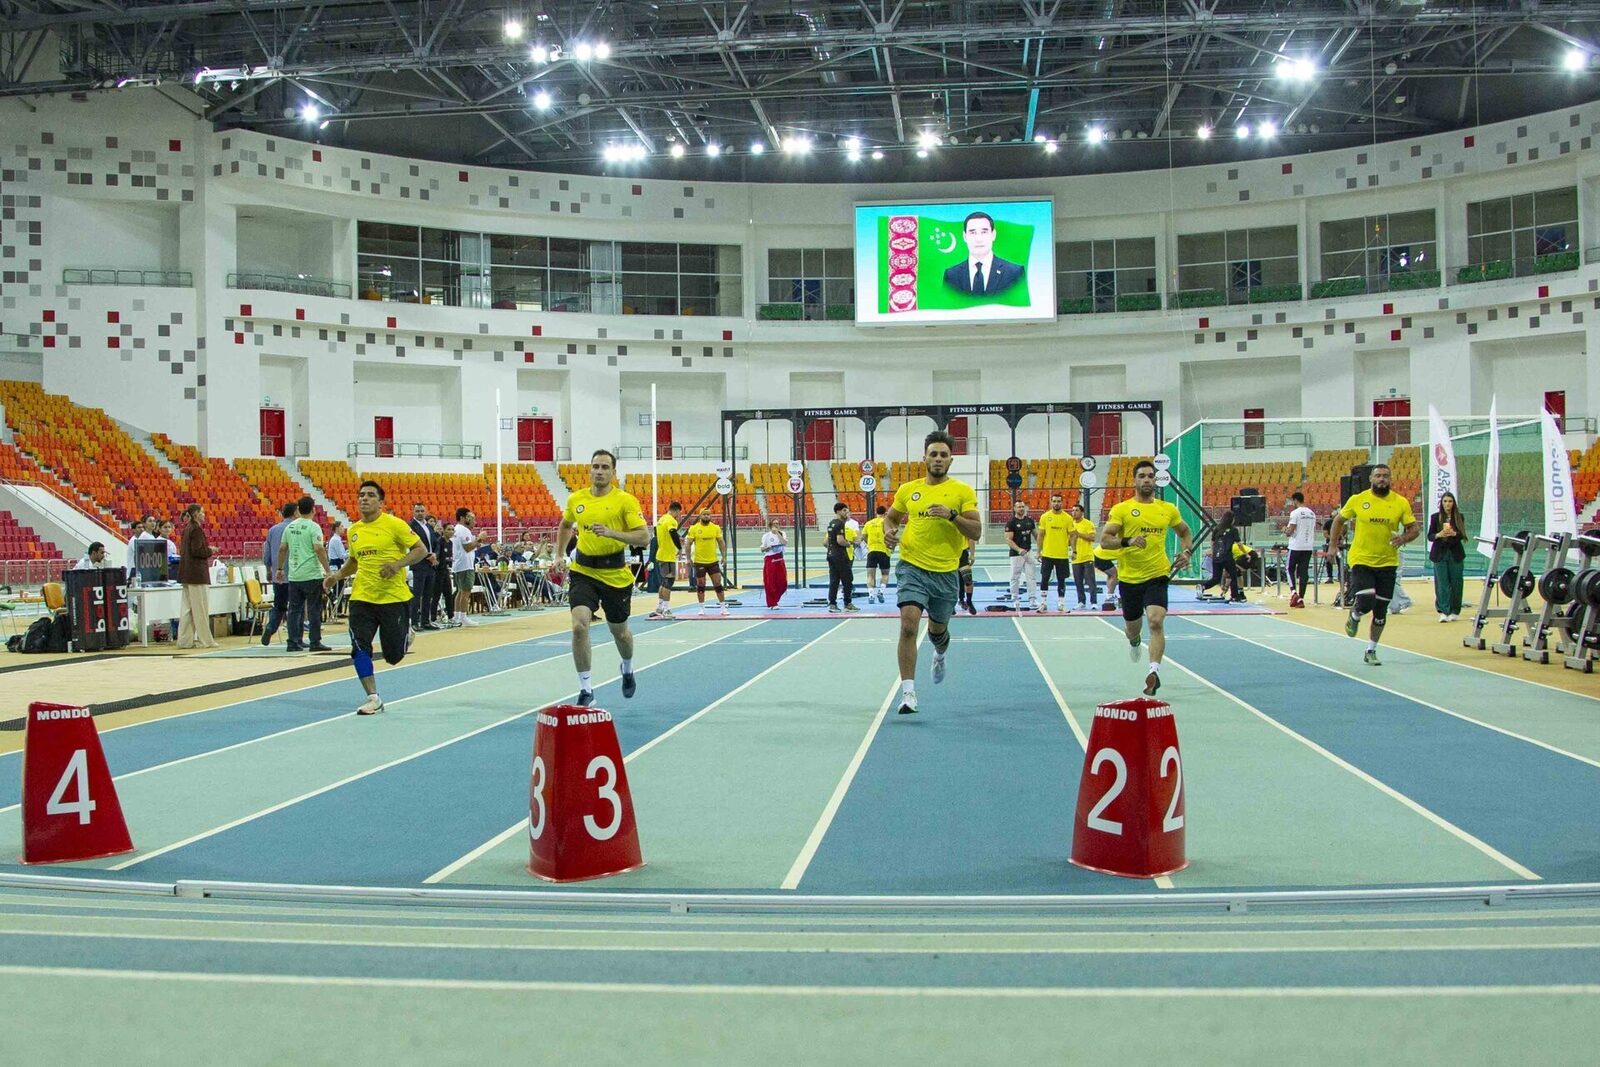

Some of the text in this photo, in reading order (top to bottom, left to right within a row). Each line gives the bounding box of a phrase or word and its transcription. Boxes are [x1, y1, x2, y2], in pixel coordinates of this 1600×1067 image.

[140, 552, 162, 568] 00:00
[92, 586, 106, 632] bold
[116, 585, 128, 630] bold
[37, 707, 90, 720] MONDO
[567, 712, 612, 726] MONDO
[1096, 706, 1138, 720] MONDO
[46, 749, 96, 824] 4
[529, 756, 546, 840] 3
[583, 756, 622, 840] 3
[1087, 748, 1128, 836] 2
[1160, 746, 1184, 832] 2
